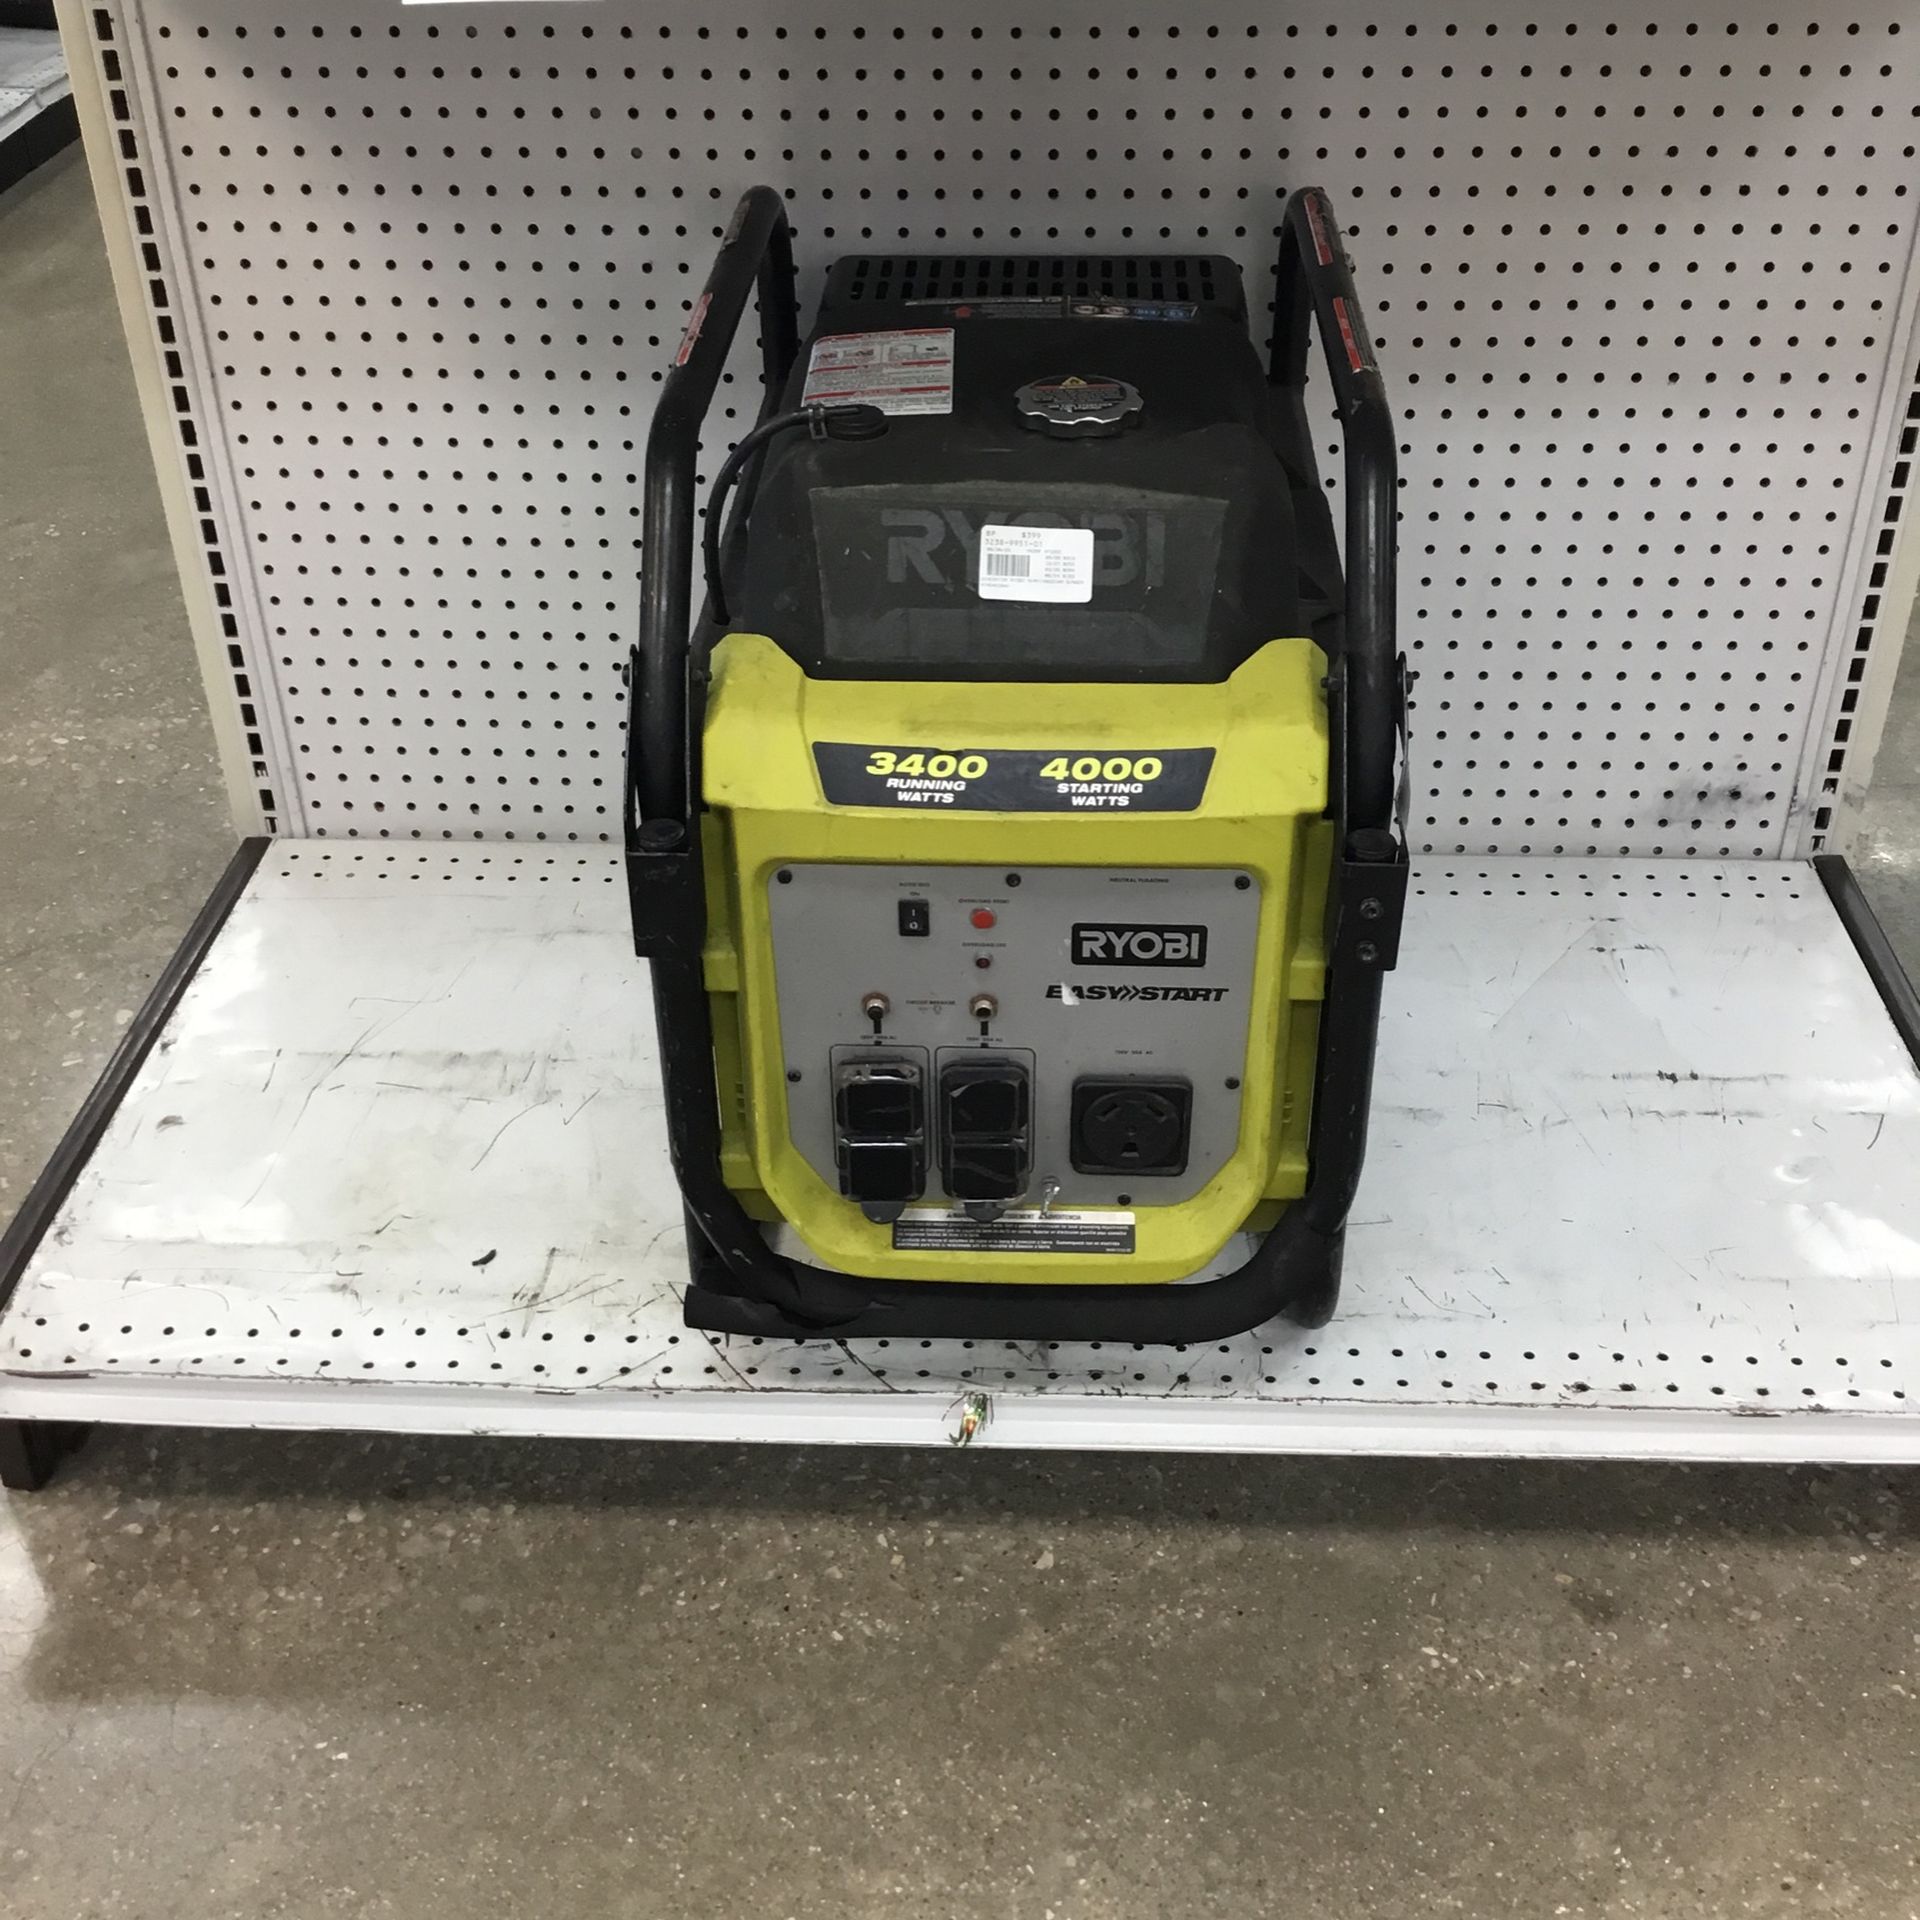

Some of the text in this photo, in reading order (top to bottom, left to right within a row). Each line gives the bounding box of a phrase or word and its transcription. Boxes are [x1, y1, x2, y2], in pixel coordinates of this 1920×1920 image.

[880, 508, 1166, 587] RYBI
[865, 751, 988, 779] 3400
[1039, 757, 1163, 781] 4000
[886, 778, 967, 791] RUNNING
[1057, 782, 1144, 794] STARTING
[897, 790, 955, 803] WATTS
[1071, 795, 1130, 806] WATTS
[1079, 930, 1200, 960] RYOBI
